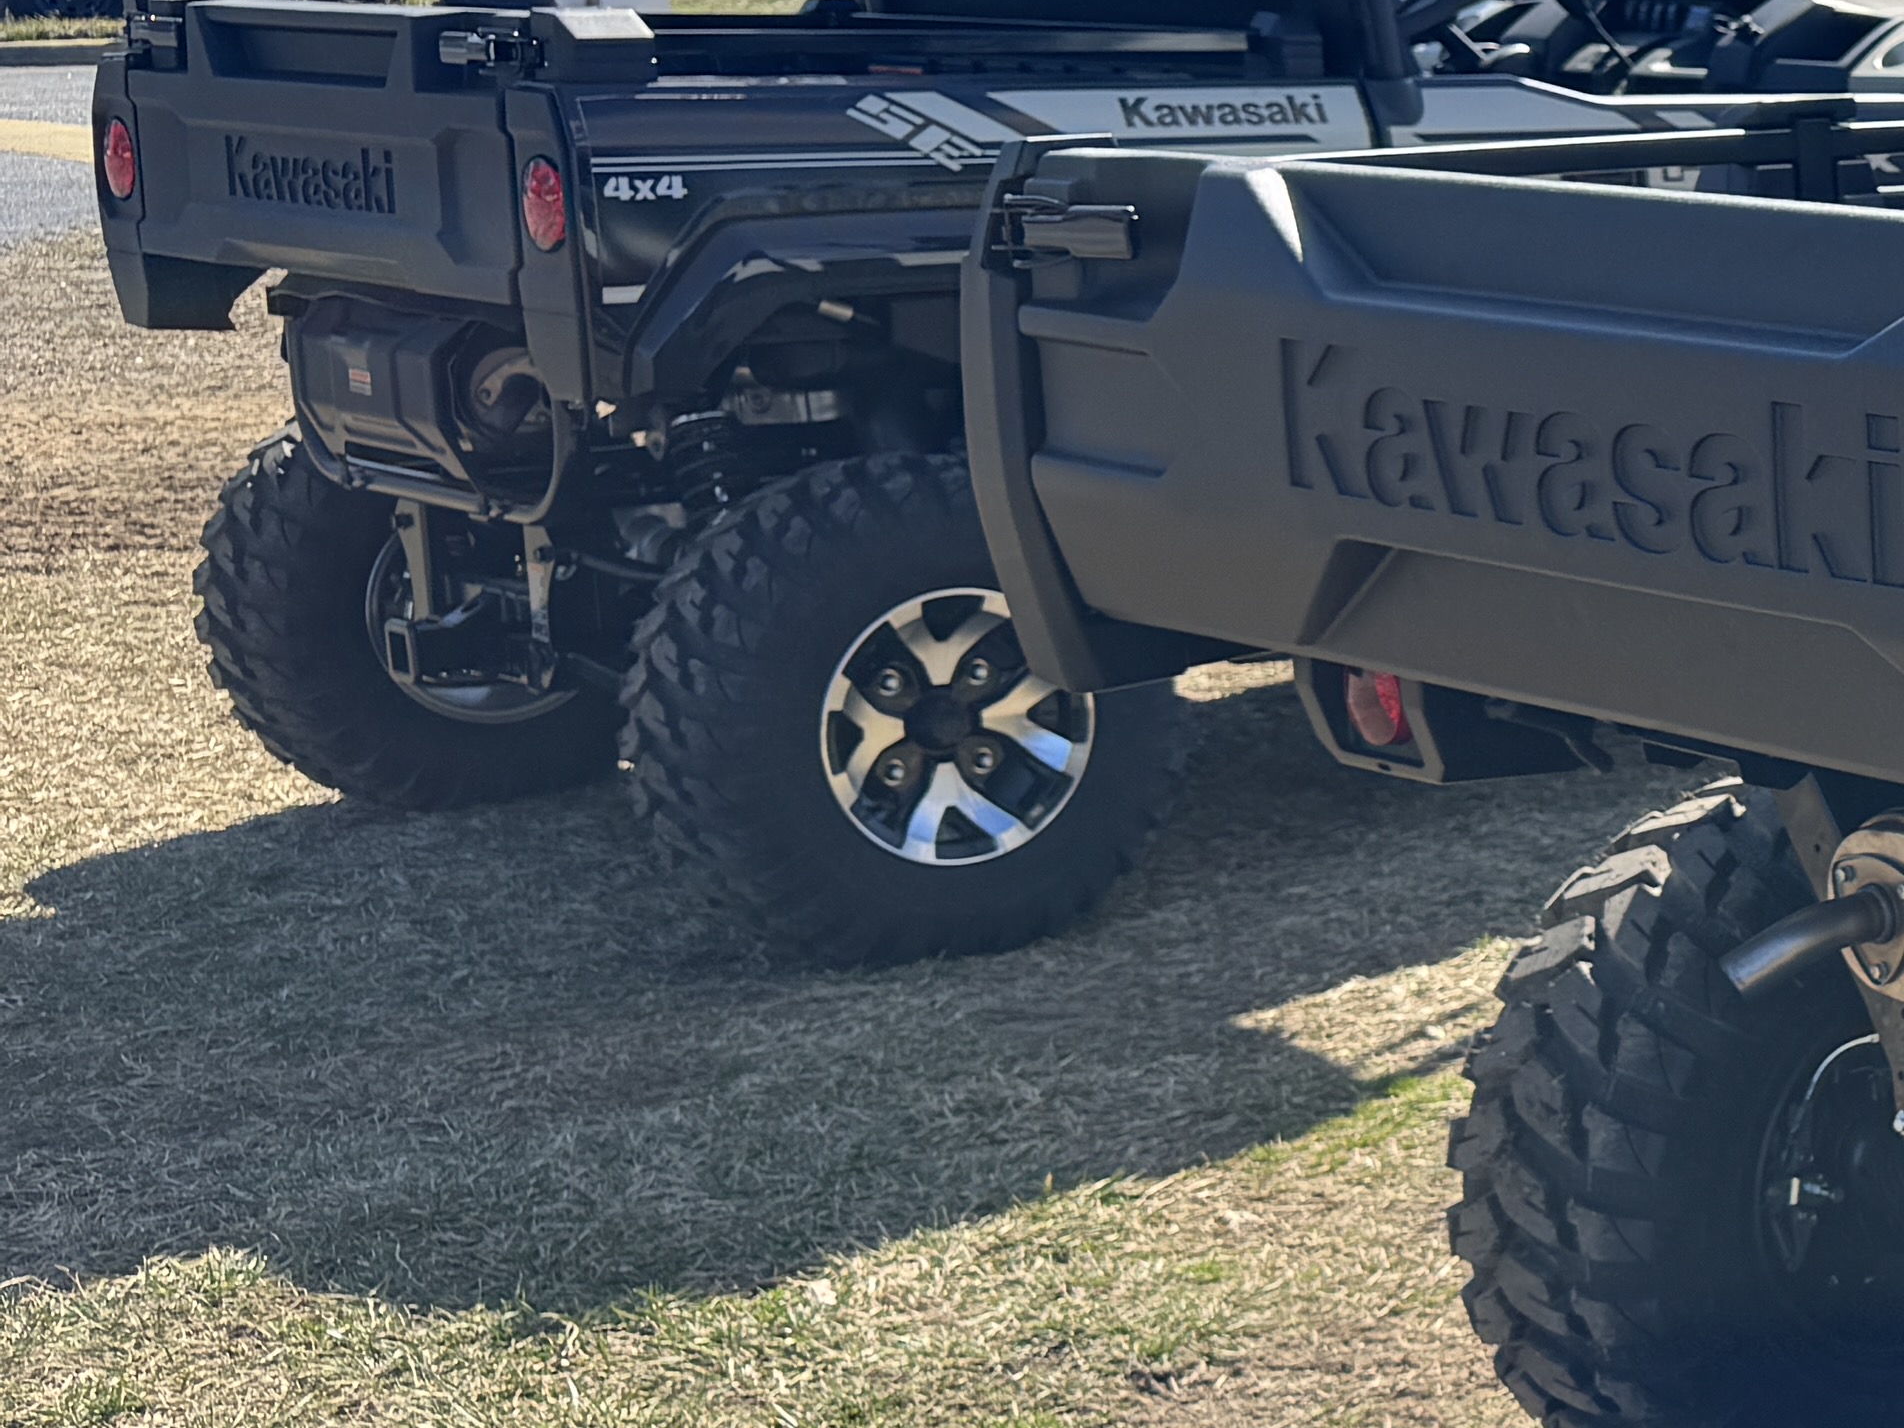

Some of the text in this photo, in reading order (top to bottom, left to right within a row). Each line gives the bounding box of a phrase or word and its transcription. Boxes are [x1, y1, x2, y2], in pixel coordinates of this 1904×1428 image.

[1118, 93, 1329, 128] Kawasaki
[225, 135, 396, 214] Kawasaki
[604, 175, 688, 201] 4x4
